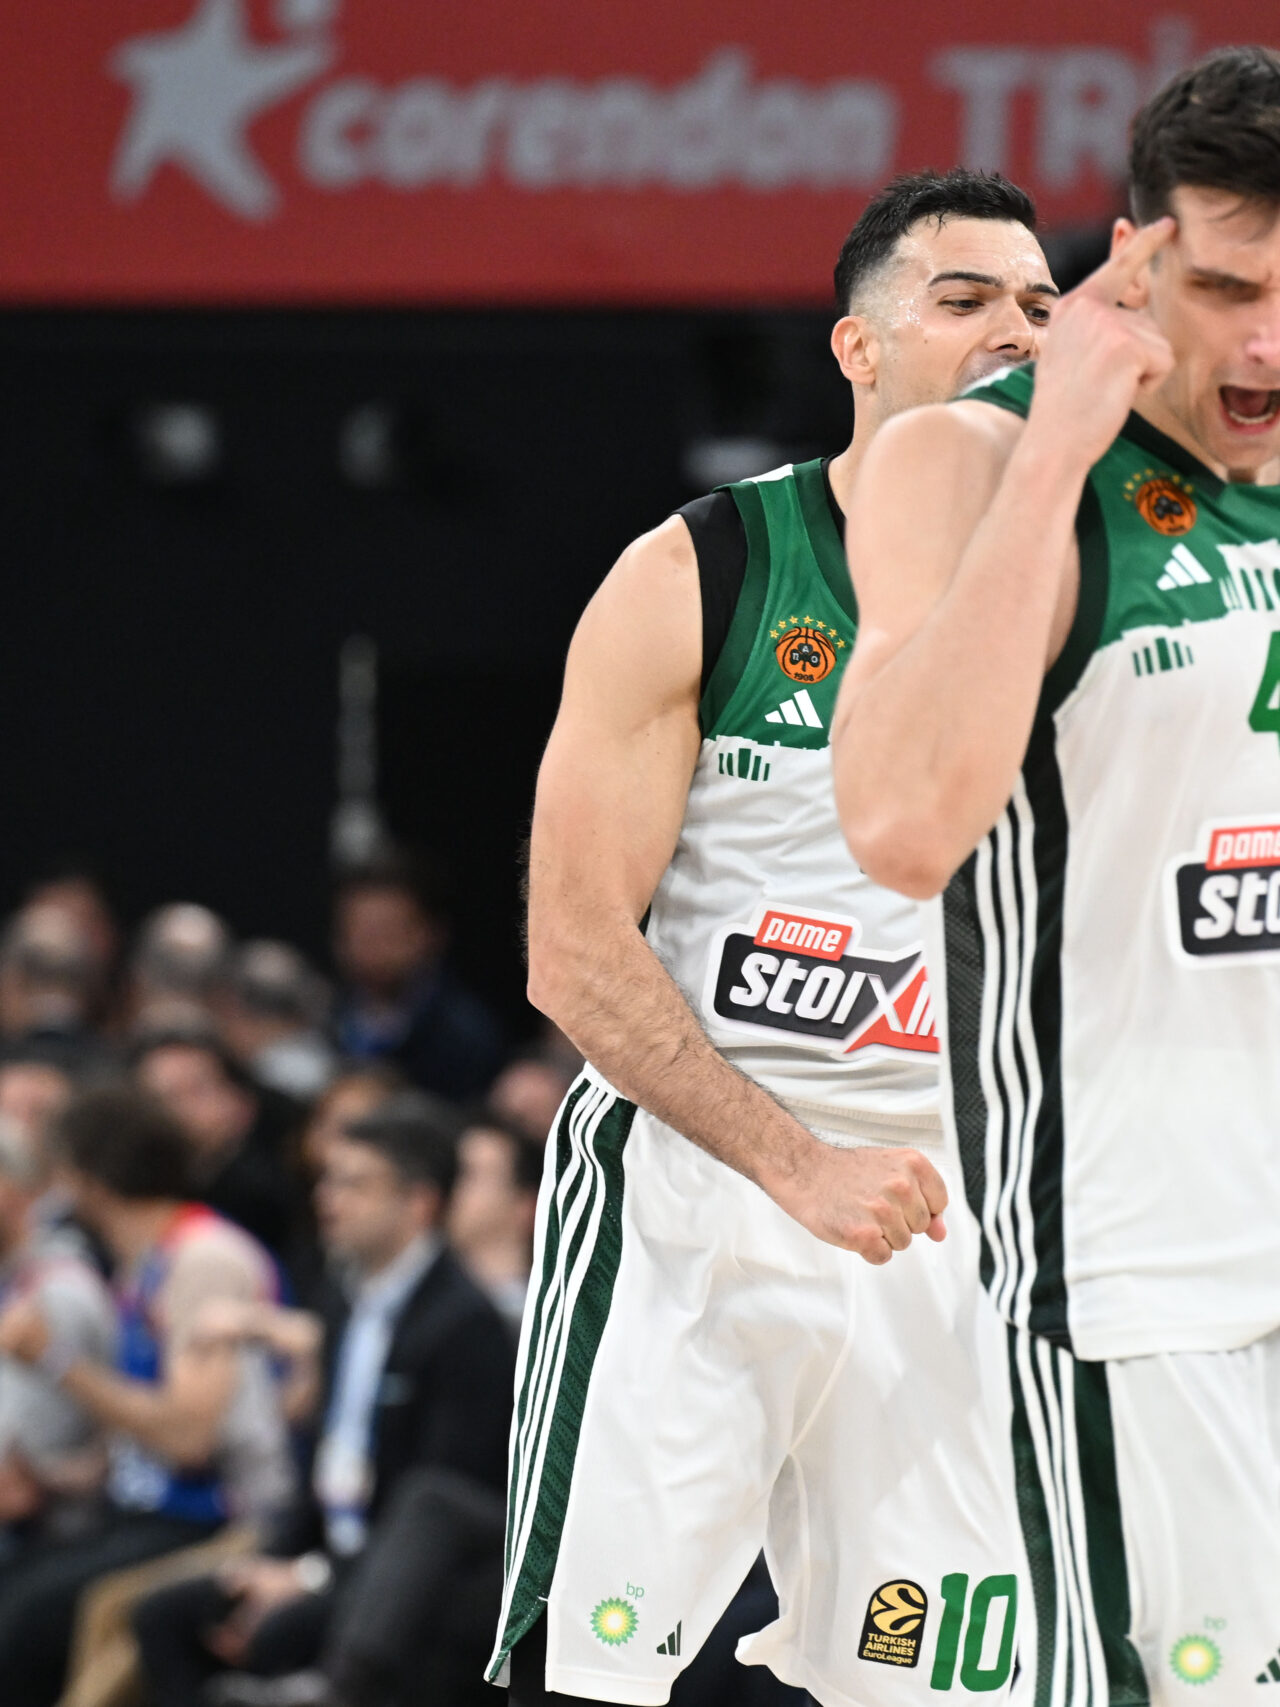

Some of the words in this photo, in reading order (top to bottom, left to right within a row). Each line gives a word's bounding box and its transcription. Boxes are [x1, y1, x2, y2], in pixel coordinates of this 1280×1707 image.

[300, 46, 895, 190] corendon
[763, 917, 842, 952] pame
[626, 1582, 645, 1600] bp
[868, 1632, 917, 1648] TURKISH
[930, 1573, 1017, 1692] 10
[863, 1649, 913, 1664] EuroLeague
[865, 1641, 914, 1657] AIRLINES
